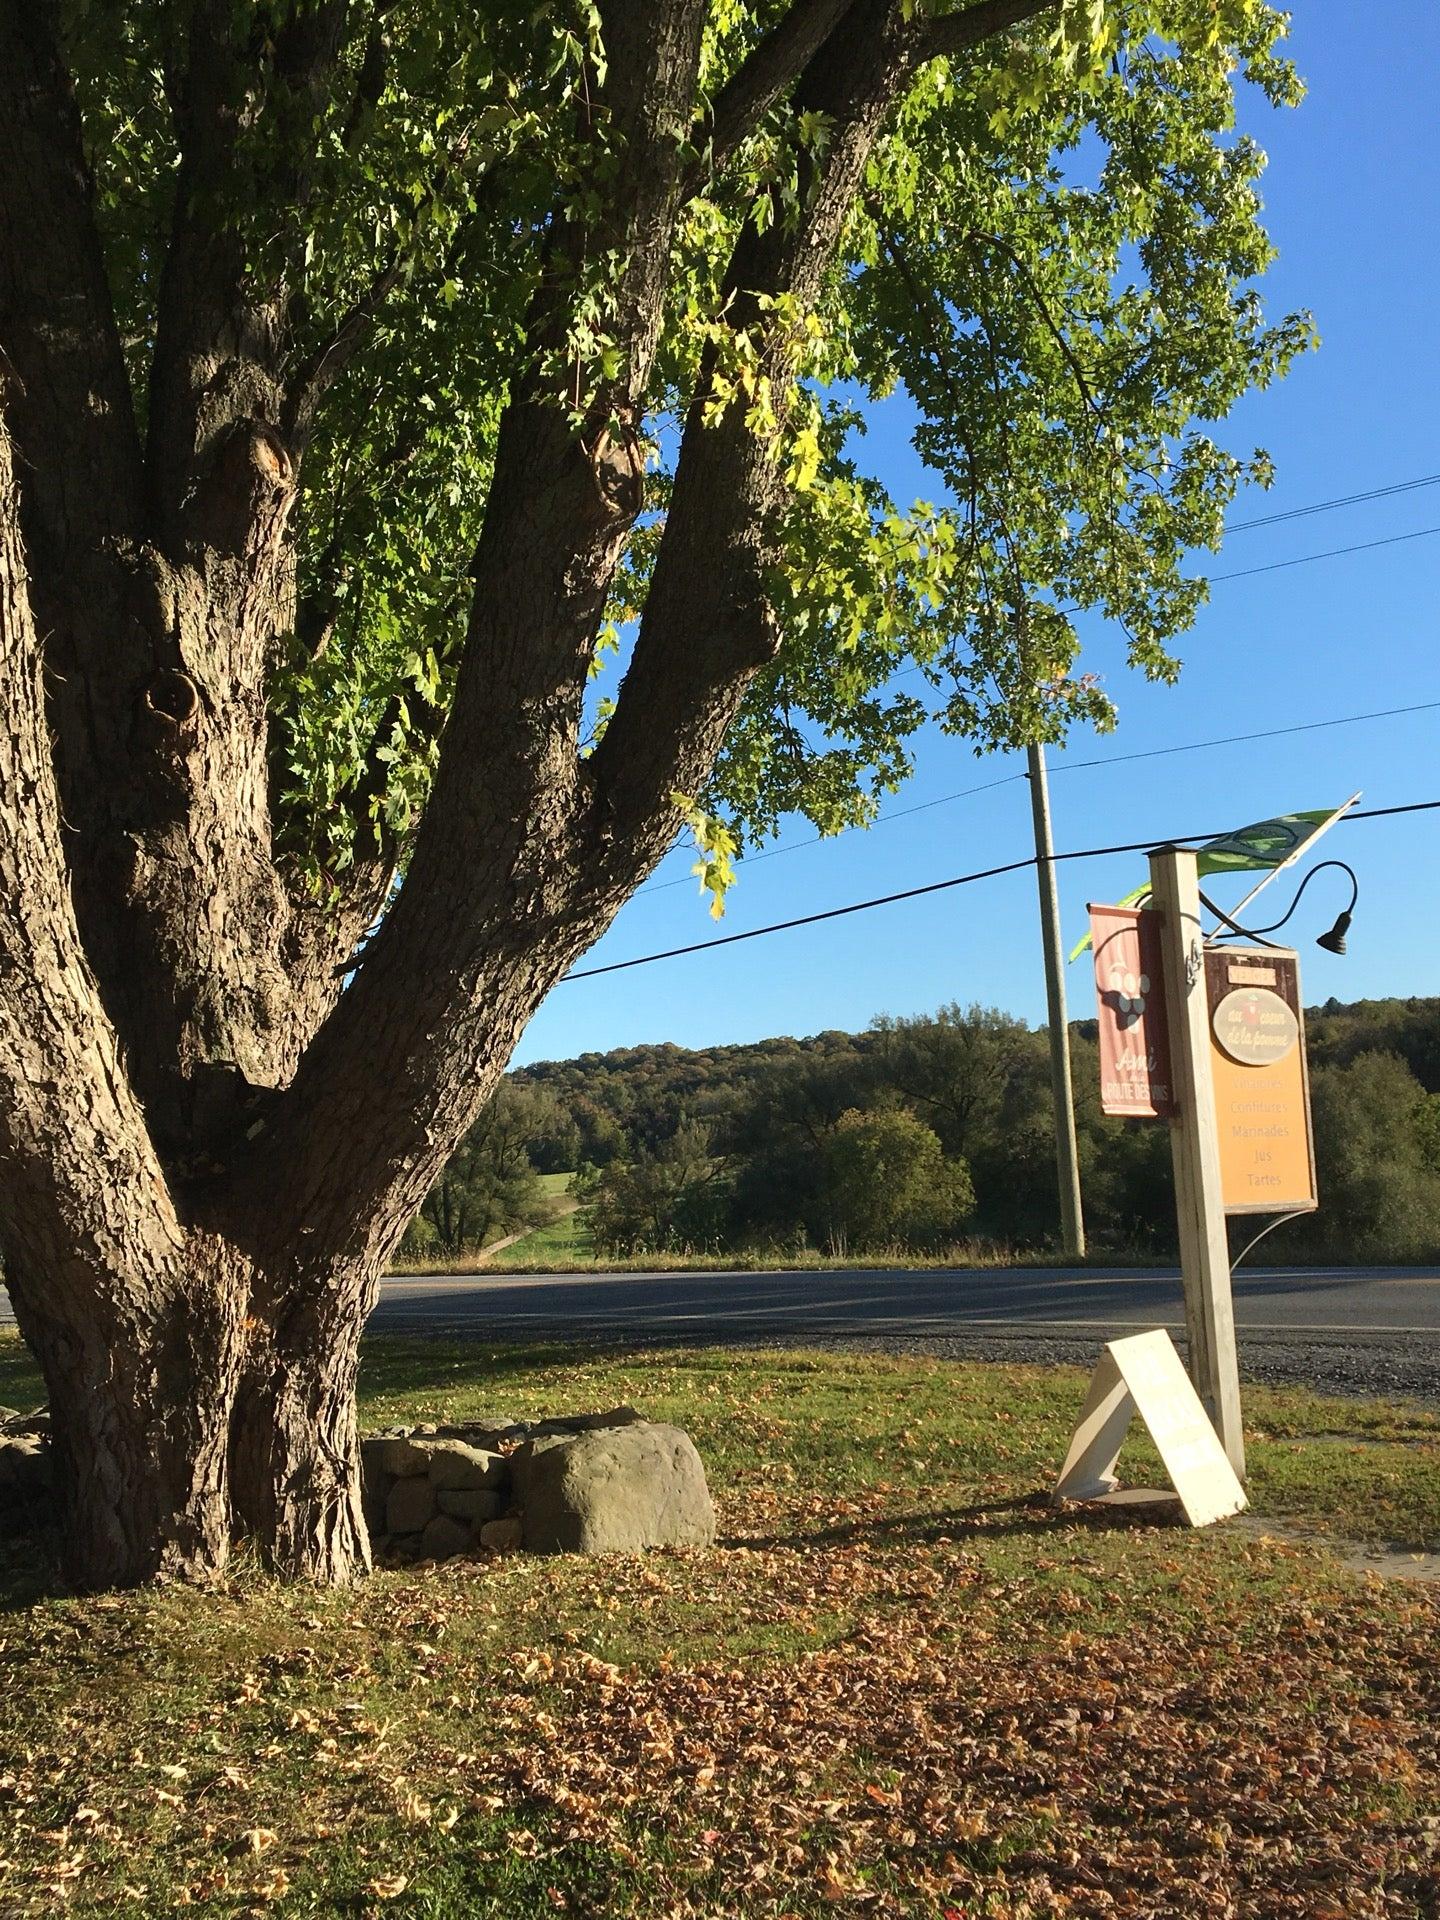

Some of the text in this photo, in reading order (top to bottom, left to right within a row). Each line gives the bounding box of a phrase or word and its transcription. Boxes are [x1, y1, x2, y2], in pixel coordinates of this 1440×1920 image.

[1115, 1046, 1157, 1073] Ami
[1105, 1082, 1134, 1100] ROUTE
[1134, 1083, 1150, 1101] DES
[1230, 1101, 1288, 1114] Confitures
[1232, 1124, 1289, 1138] Marinades
[1254, 1150, 1272, 1164] Jus
[1247, 1173, 1282, 1187] Tartes
